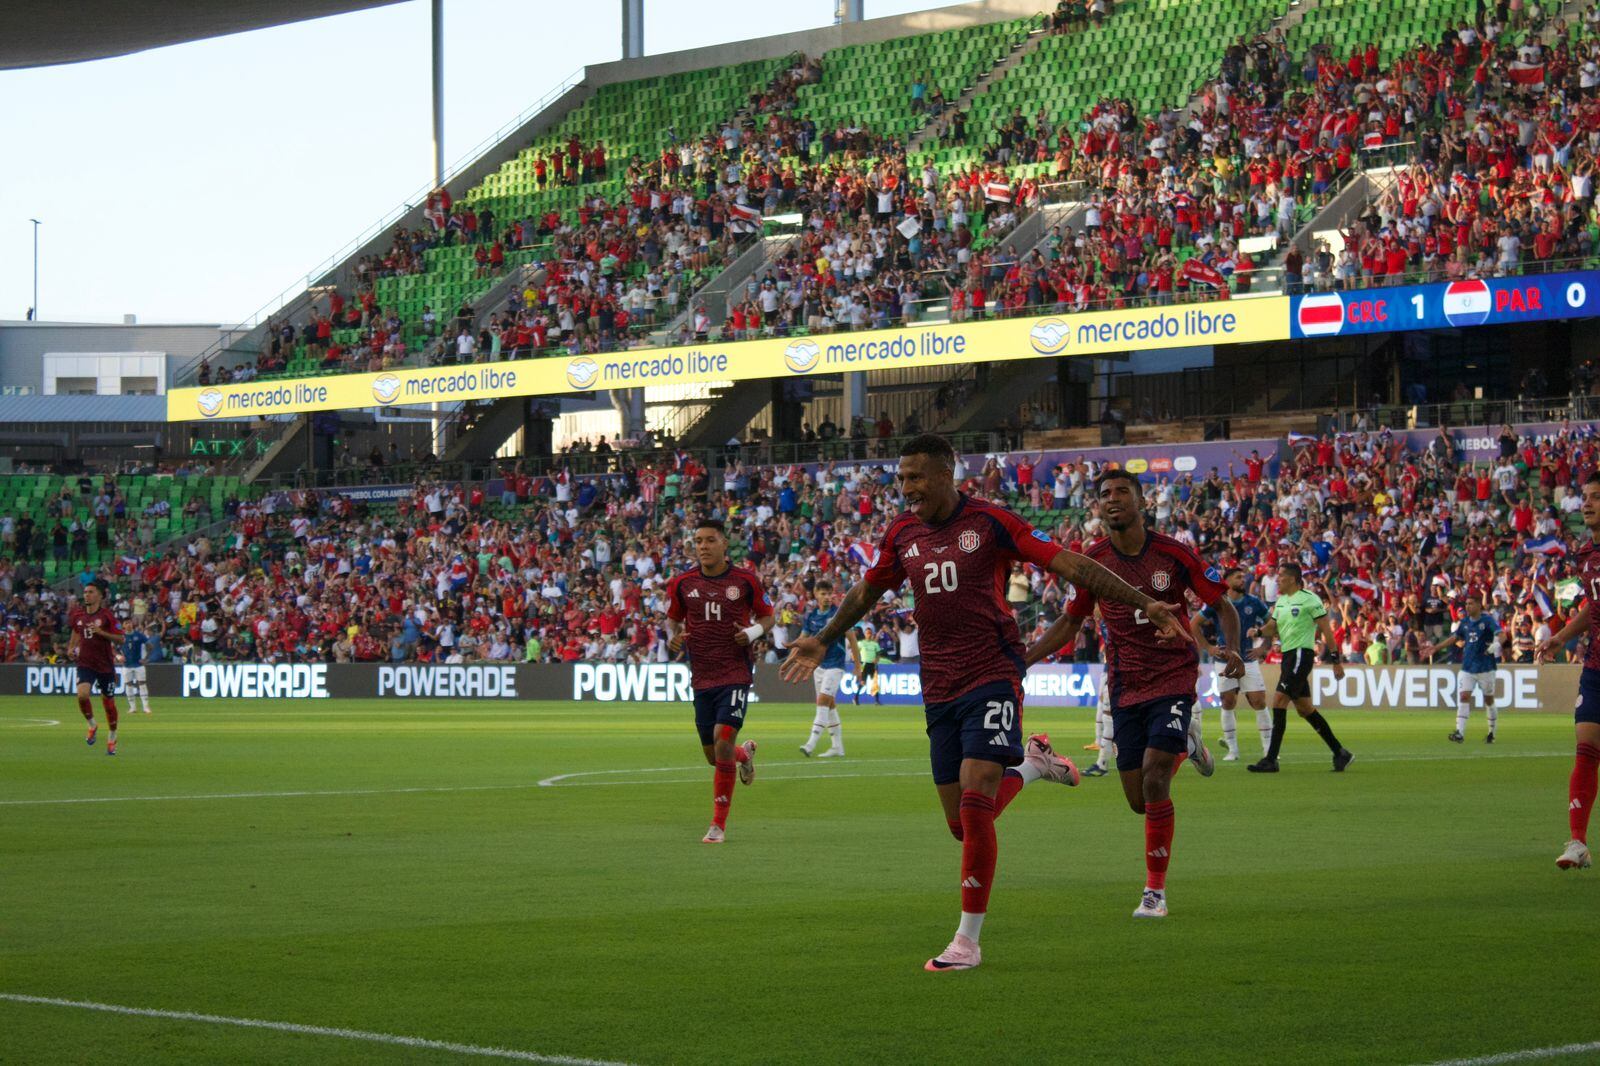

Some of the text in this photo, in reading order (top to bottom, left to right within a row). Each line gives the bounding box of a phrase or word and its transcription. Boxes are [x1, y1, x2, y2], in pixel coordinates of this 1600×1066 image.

[1347, 282, 1586, 323] CRC 1 PAR 0
[1077, 310, 1237, 344] mercado libre
[826, 332, 966, 363] mercado libre
[604, 352, 728, 380] mercado libre
[405, 367, 517, 395] mercado libre
[227, 383, 328, 409] mercado libre
[191, 439, 245, 455] ATX
[923, 560, 959, 594] 20
[705, 601, 721, 621] 14
[84, 627, 94, 639] 13
[182, 664, 327, 698] POWERADE
[378, 666, 516, 698] POWERADE
[1022, 673, 1096, 697] MERICA
[730, 689, 746, 709] 14
[983, 700, 1014, 731] 20
